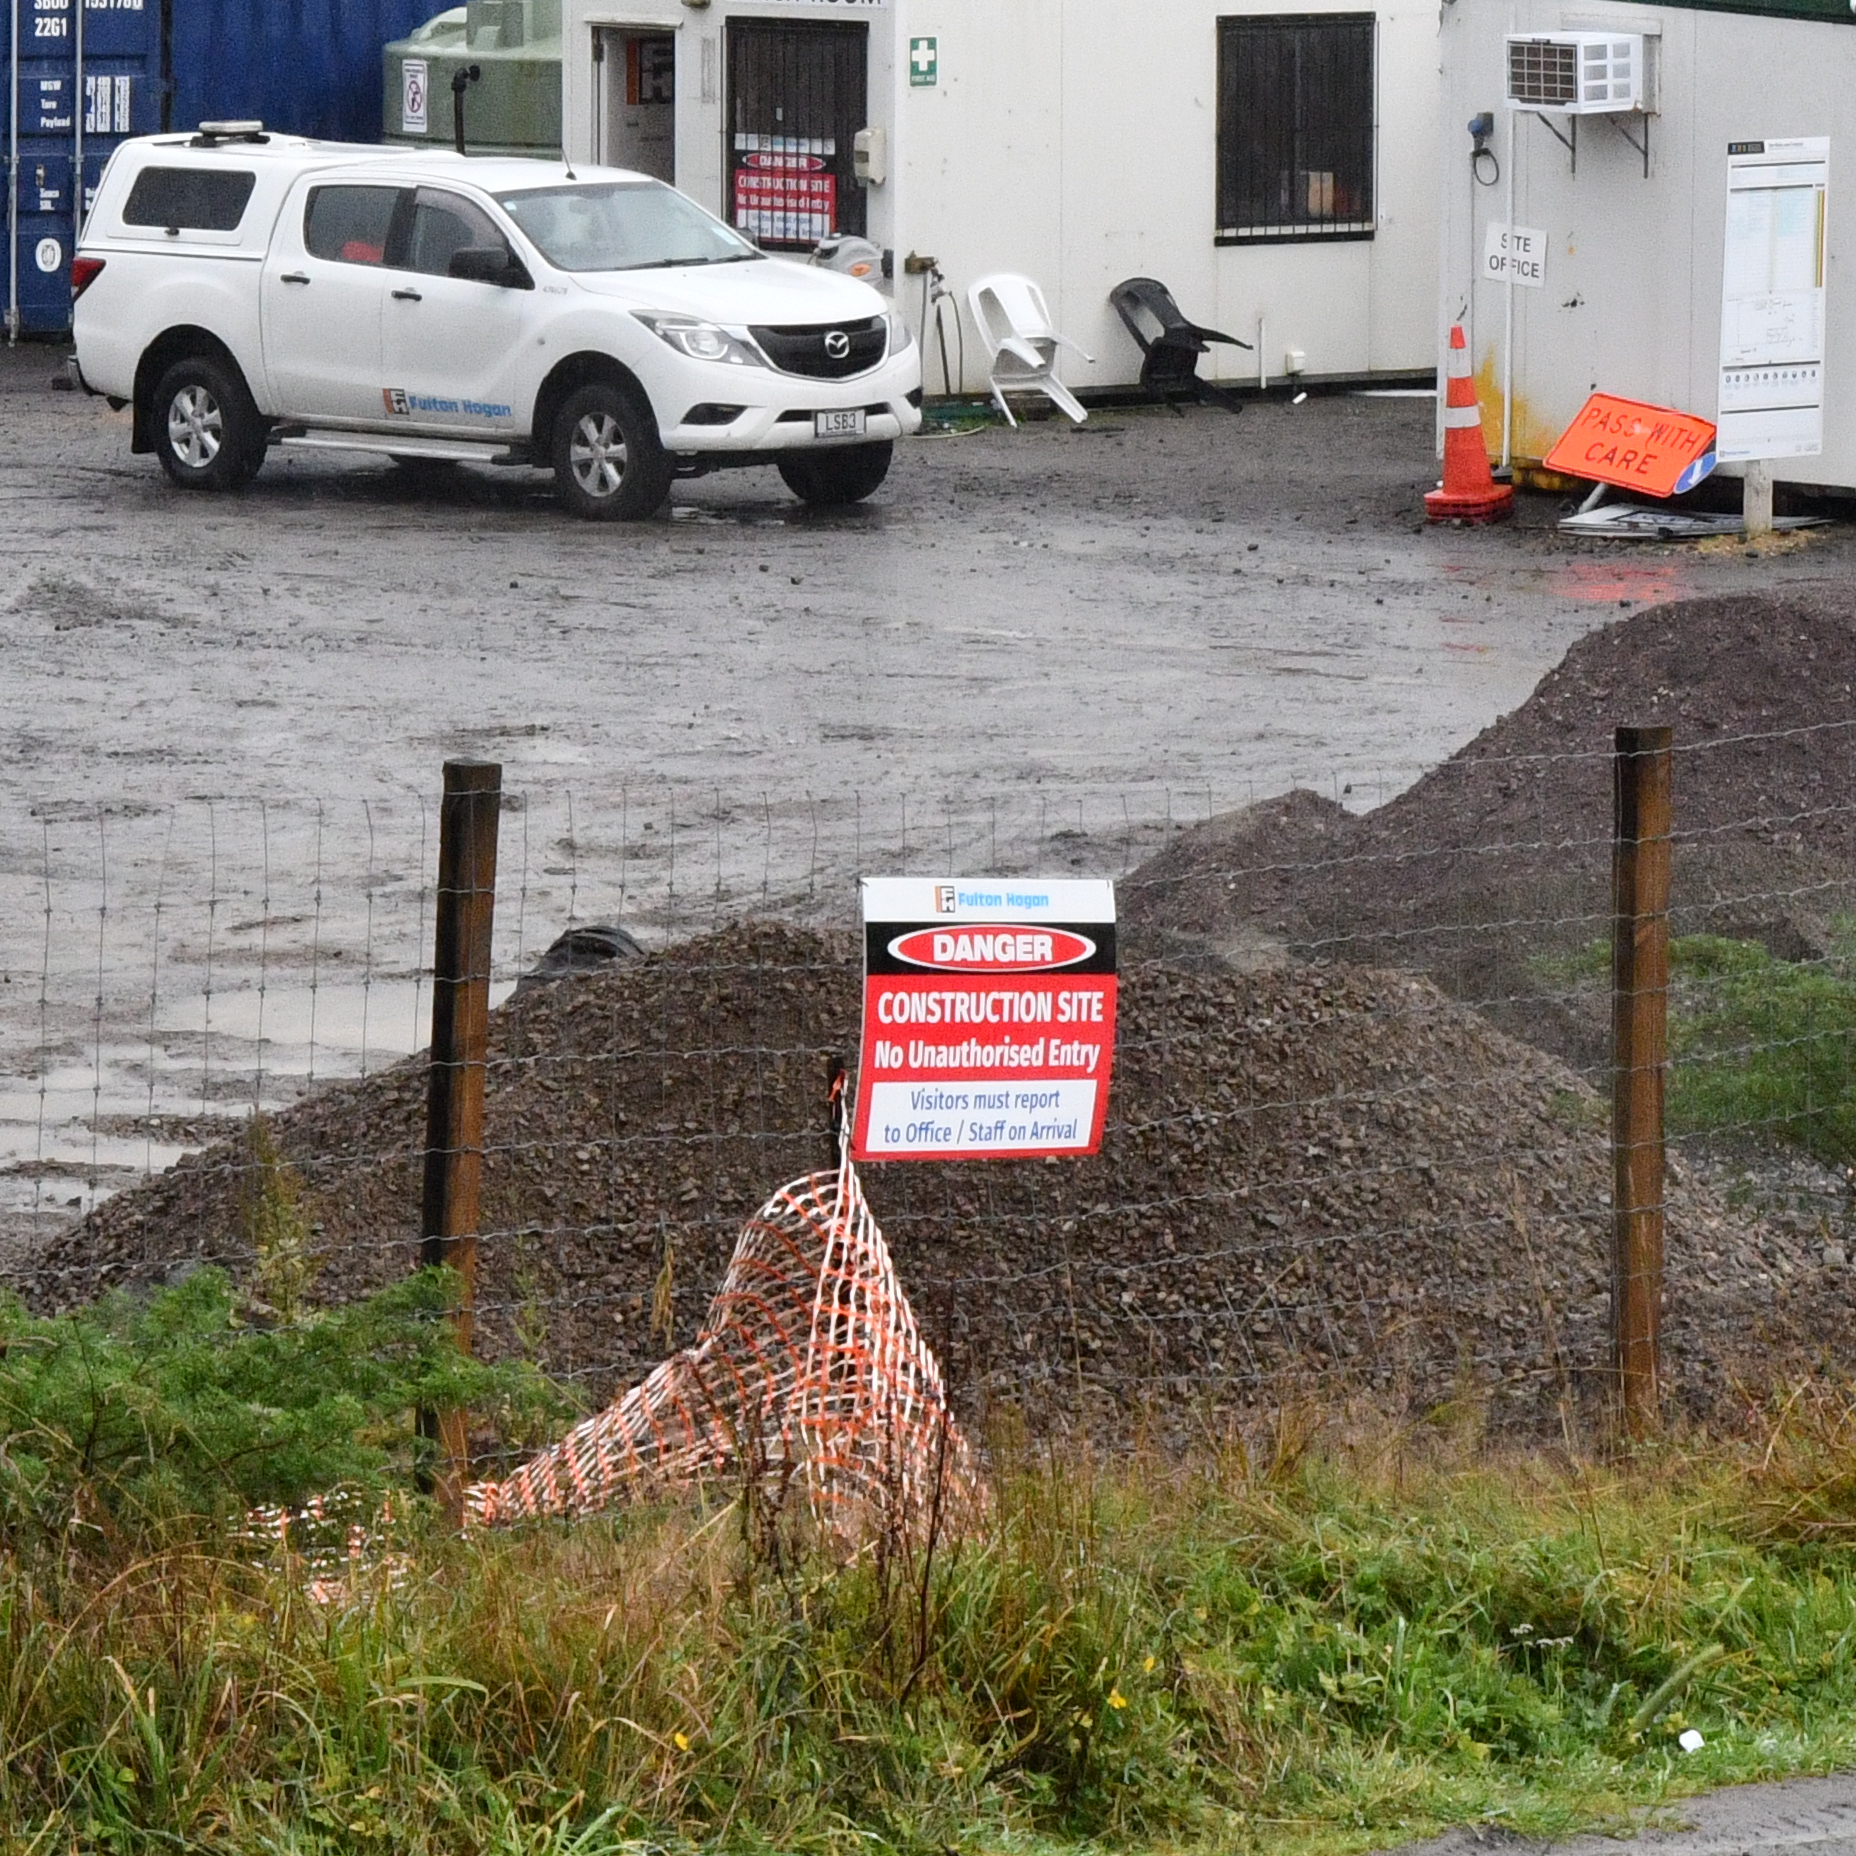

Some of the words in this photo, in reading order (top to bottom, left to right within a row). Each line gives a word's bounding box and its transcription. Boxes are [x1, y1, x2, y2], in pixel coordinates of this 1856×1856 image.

[35, 17, 67, 37] 22G1
[759, 156, 809, 169] DANGER
[1501, 232, 1531, 253] STE
[408, 396, 459, 412] Fulton
[461, 399, 512, 418] Hogan
[1581, 407, 1642, 437] PASS
[1645, 422, 1702, 452] WITH
[1584, 442, 1658, 474] CARE
[958, 892, 1002, 906] Fulton
[1006, 892, 1049, 910] Hogan
[933, 933, 1053, 962] DANGER
[877, 990, 1052, 1024] CONSTRUCTION
[1057, 990, 1104, 1023] SITE
[874, 1040, 904, 1069] No
[908, 1036, 1044, 1069] Unauthorised
[1048, 1038, 1101, 1074] Entry
[910, 1088, 969, 1111] Visitors
[973, 1092, 1011, 1111] must
[1014, 1089, 1060, 1114] report
[884, 1125, 902, 1144] to
[905, 1120, 952, 1145] Office
[956, 1119, 966, 1145] /
[968, 1120, 1006, 1142] Staff
[1008, 1124, 1027, 1141] on
[1029, 1118, 1078, 1141] Arrival
